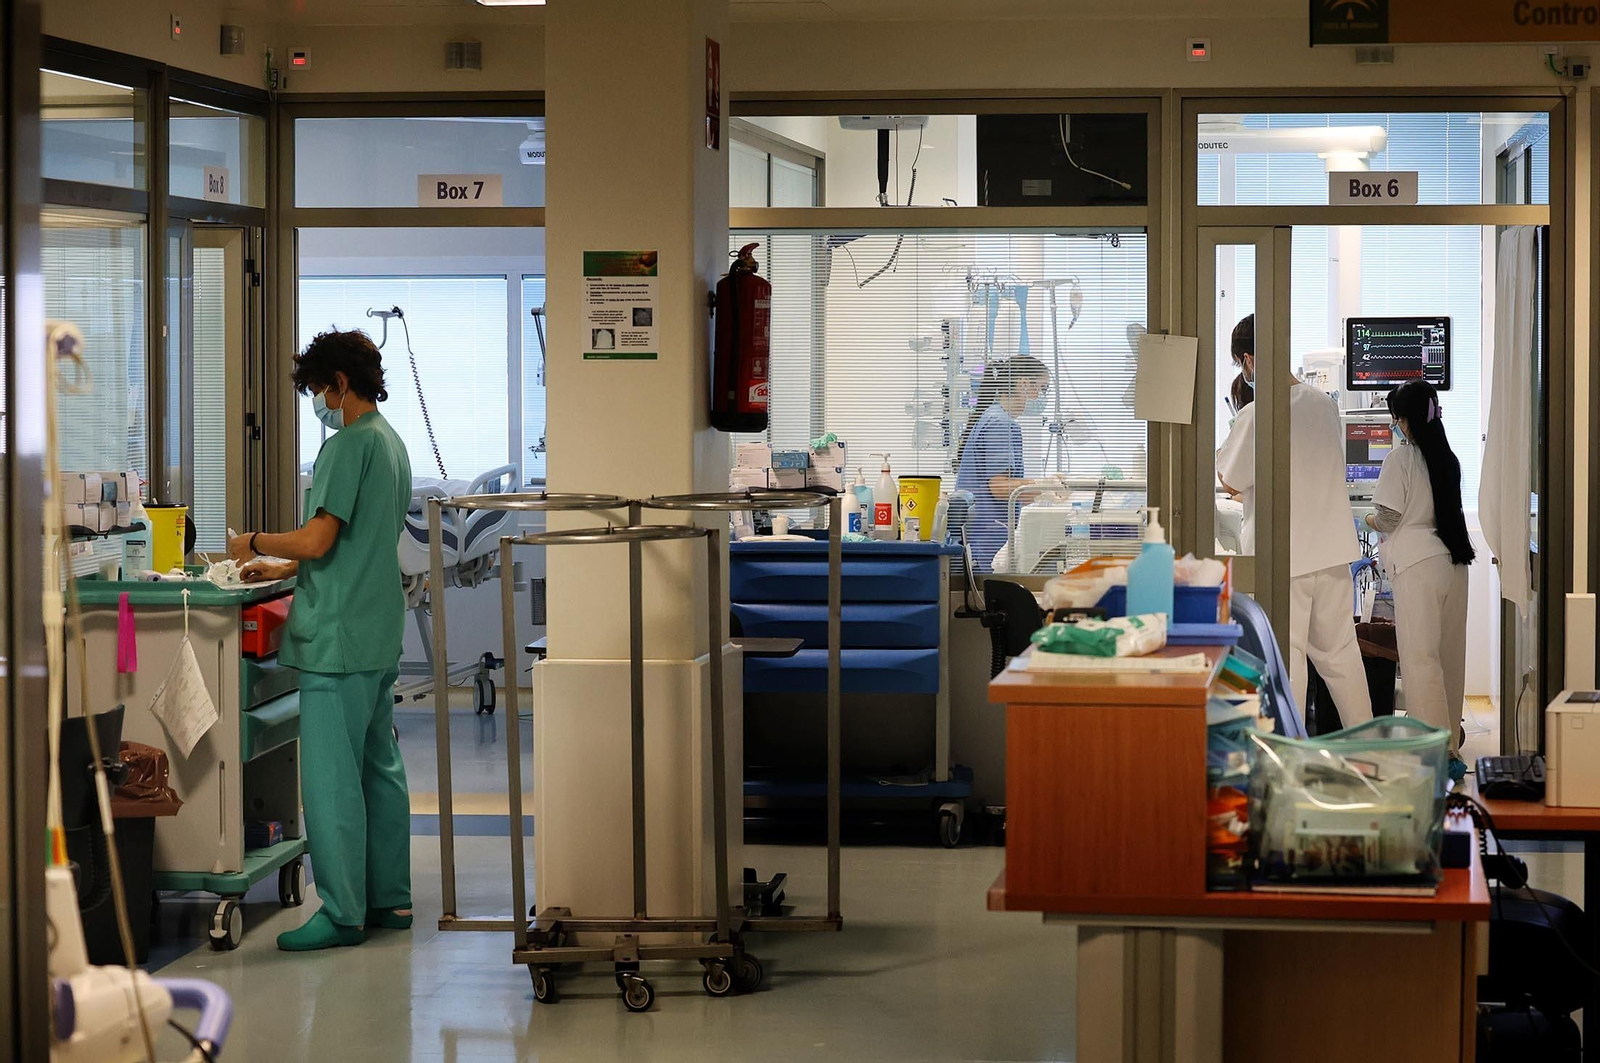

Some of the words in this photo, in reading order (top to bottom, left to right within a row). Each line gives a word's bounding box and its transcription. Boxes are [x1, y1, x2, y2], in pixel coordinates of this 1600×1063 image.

[1514, 0, 1600, 26] Contro
[208, 173, 220, 194] Box
[220, 175, 225, 195] 8
[437, 181, 468, 200] Box
[473, 181, 485, 200] 7
[1349, 179, 1382, 198] Box
[1387, 178, 1399, 198] 6
[1357, 329, 1371, 337] 114
[1362, 343, 1371, 351] 97
